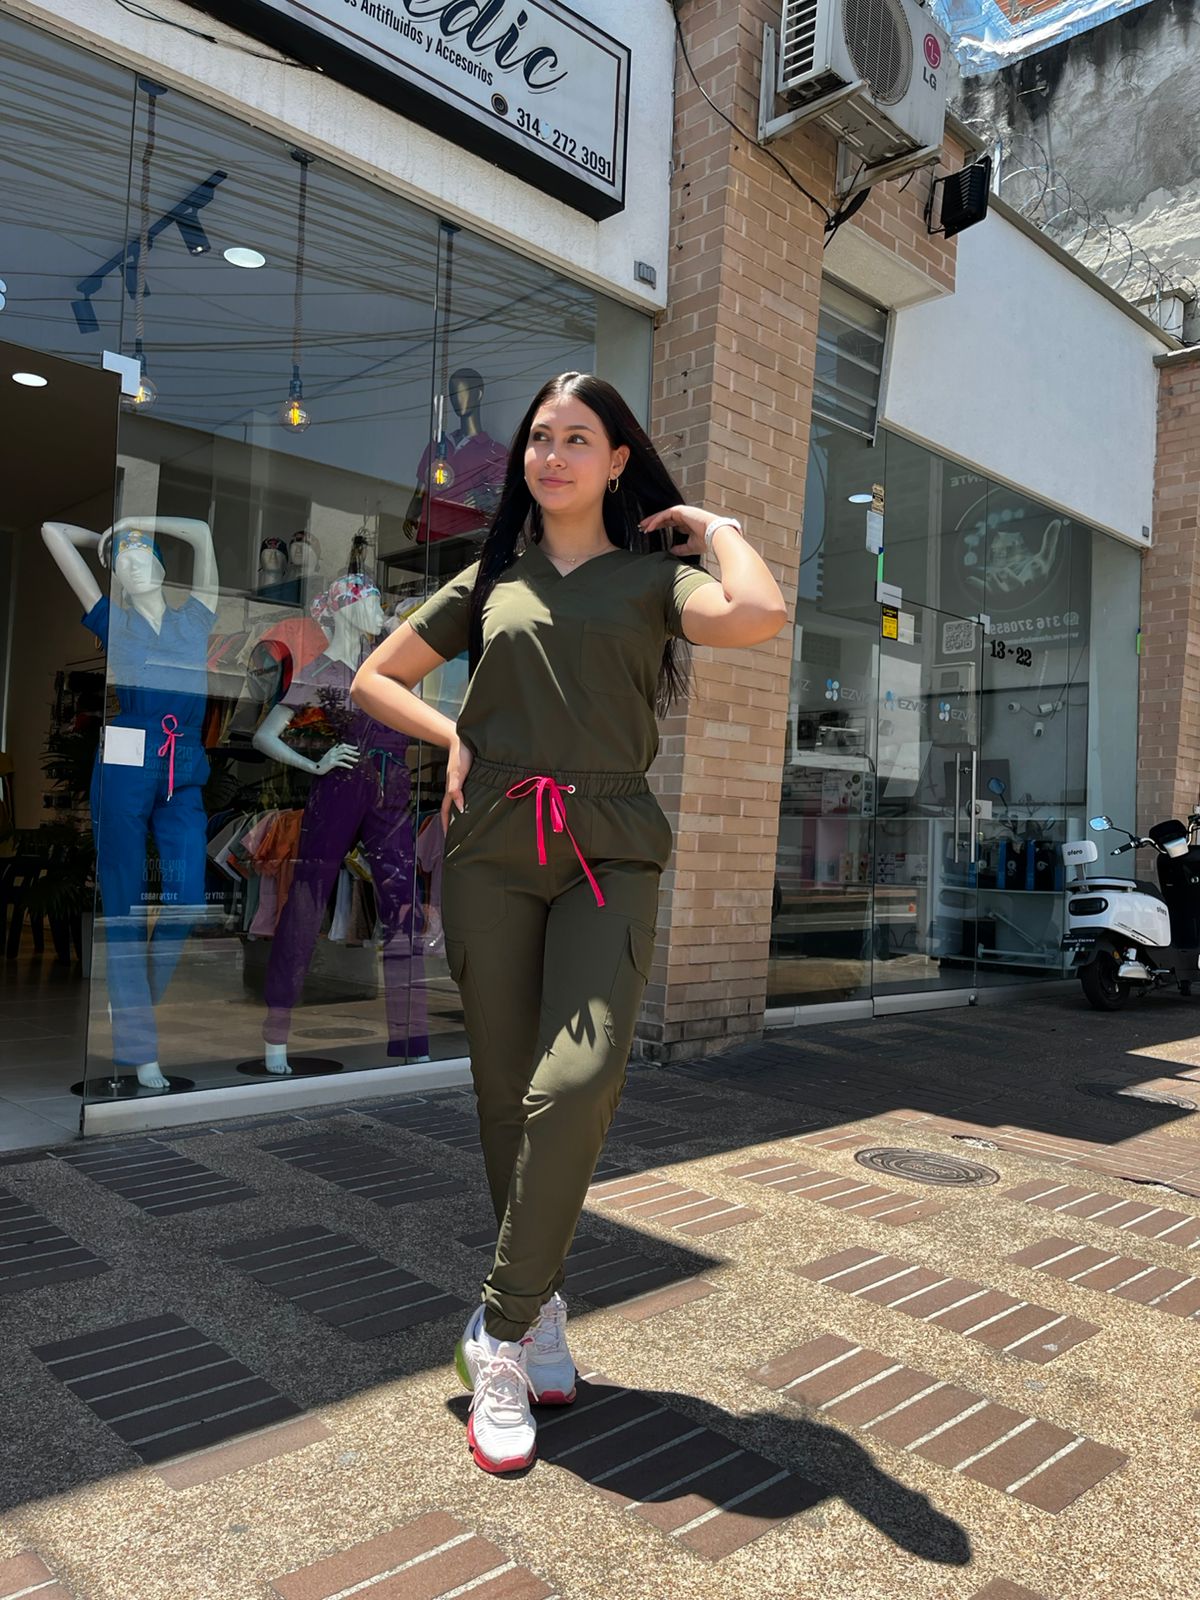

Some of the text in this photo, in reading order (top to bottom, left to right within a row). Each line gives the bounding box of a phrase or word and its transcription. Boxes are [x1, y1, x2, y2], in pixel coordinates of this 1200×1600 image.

[361, 0, 423, 45] Antifluidos
[425, 35, 433, 53] y
[435, 38, 493, 86] Accesorios
[923, 66, 937, 91] LG
[516, 107, 611, 179] 314 272 3091
